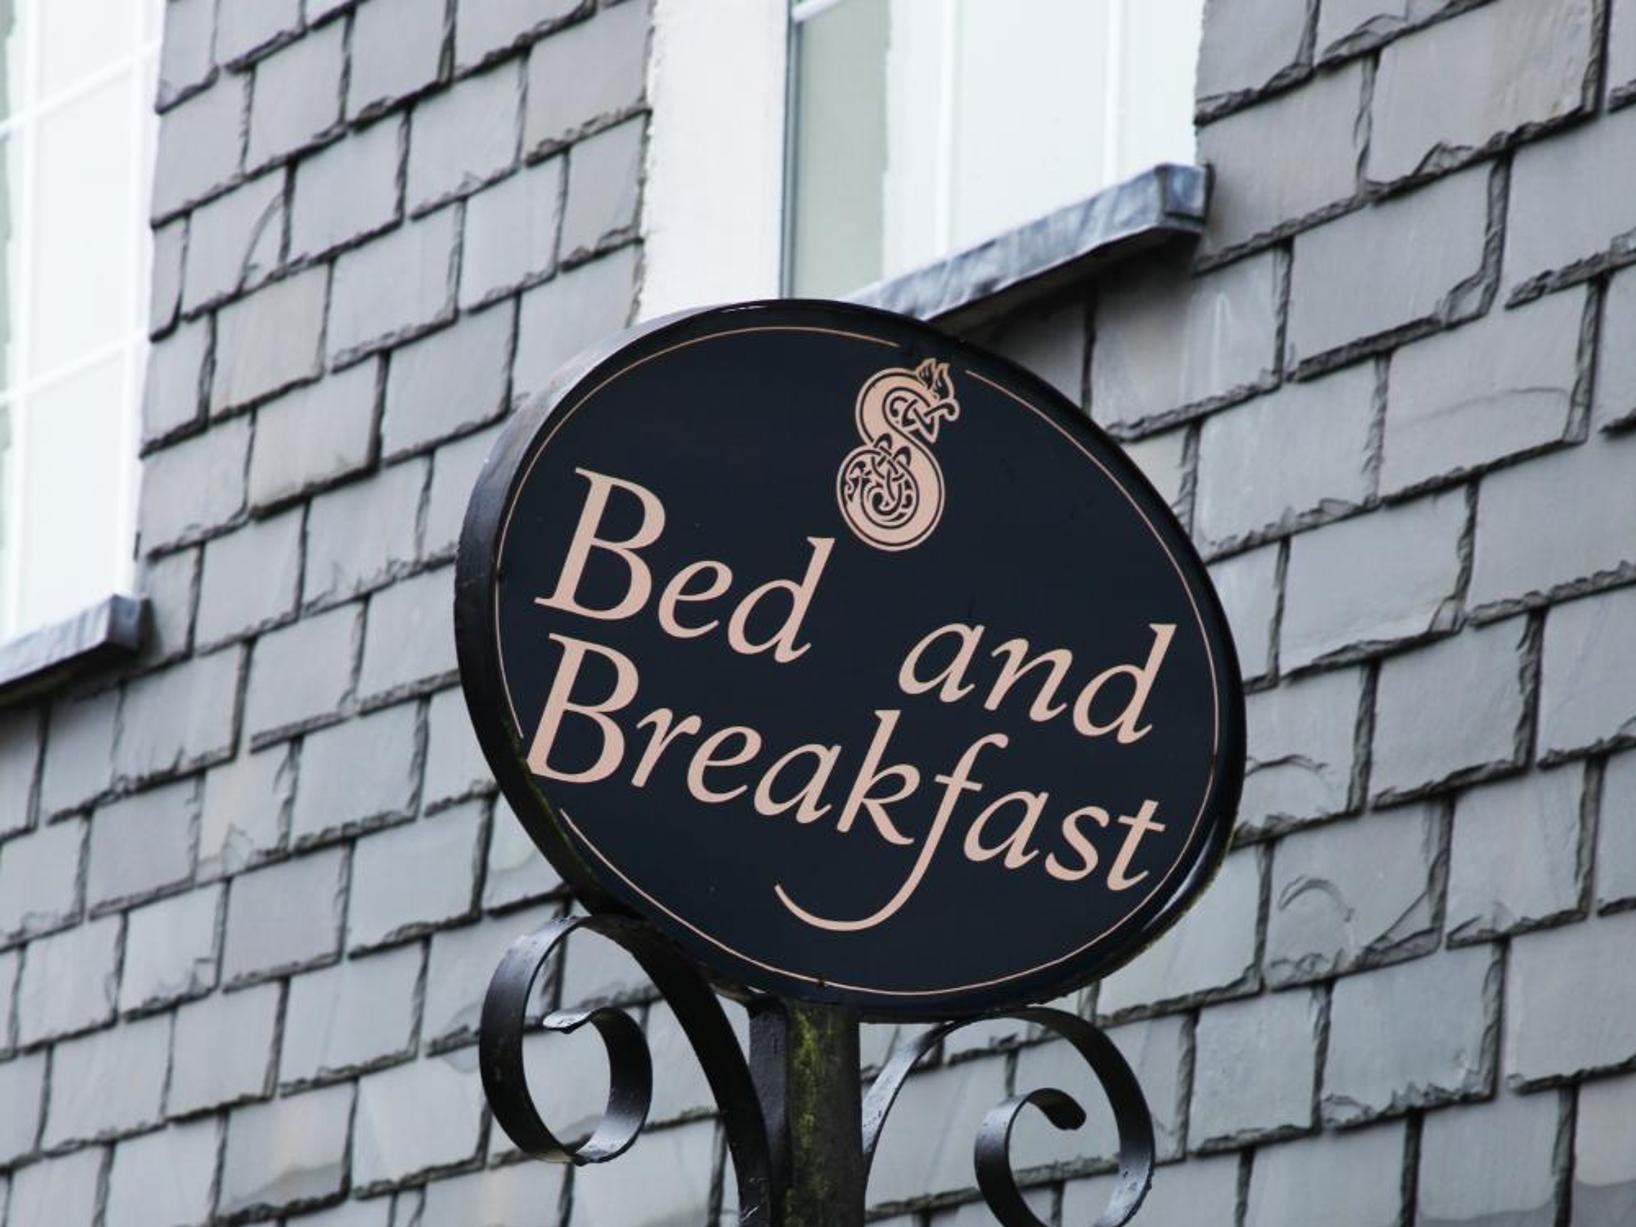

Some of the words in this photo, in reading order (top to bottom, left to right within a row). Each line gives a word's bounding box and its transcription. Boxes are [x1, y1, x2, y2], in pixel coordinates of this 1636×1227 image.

[534, 468, 835, 663] Bed
[898, 622, 1177, 745] and
[526, 633, 1167, 932] Breakfast
